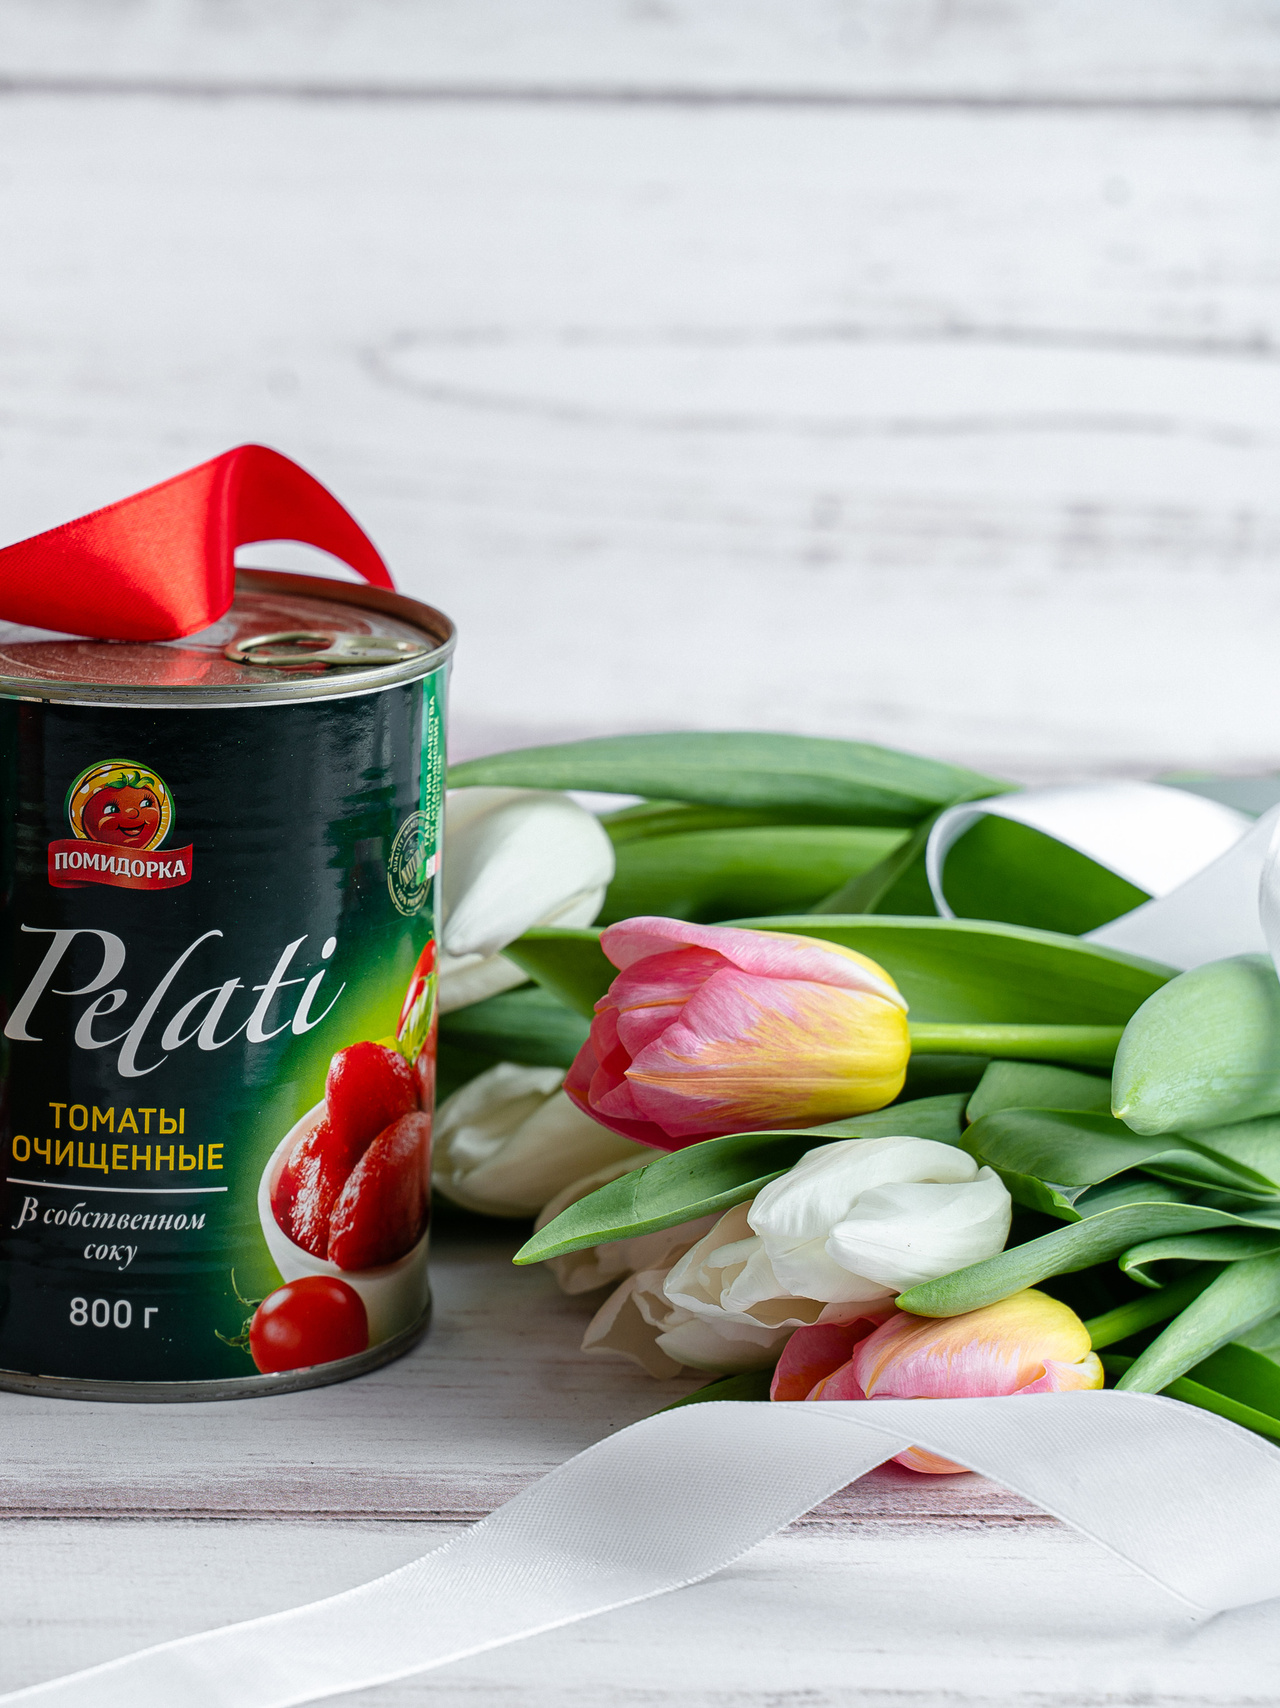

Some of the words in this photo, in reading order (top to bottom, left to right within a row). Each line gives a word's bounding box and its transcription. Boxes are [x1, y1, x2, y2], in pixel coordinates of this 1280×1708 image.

[54, 851, 187, 881] ПОМИДОРКА
[3, 923, 346, 1078] Pelati
[49, 1102, 185, 1135] ТОМАТЫ
[12, 1135, 224, 1175] ОЧИЩЕННЫЕ
[12, 1196, 38, 1230] В
[43, 1201, 206, 1231] собственном
[83, 1241, 138, 1271] соку
[69, 1297, 132, 1329] 800
[144, 1306, 158, 1329] г
